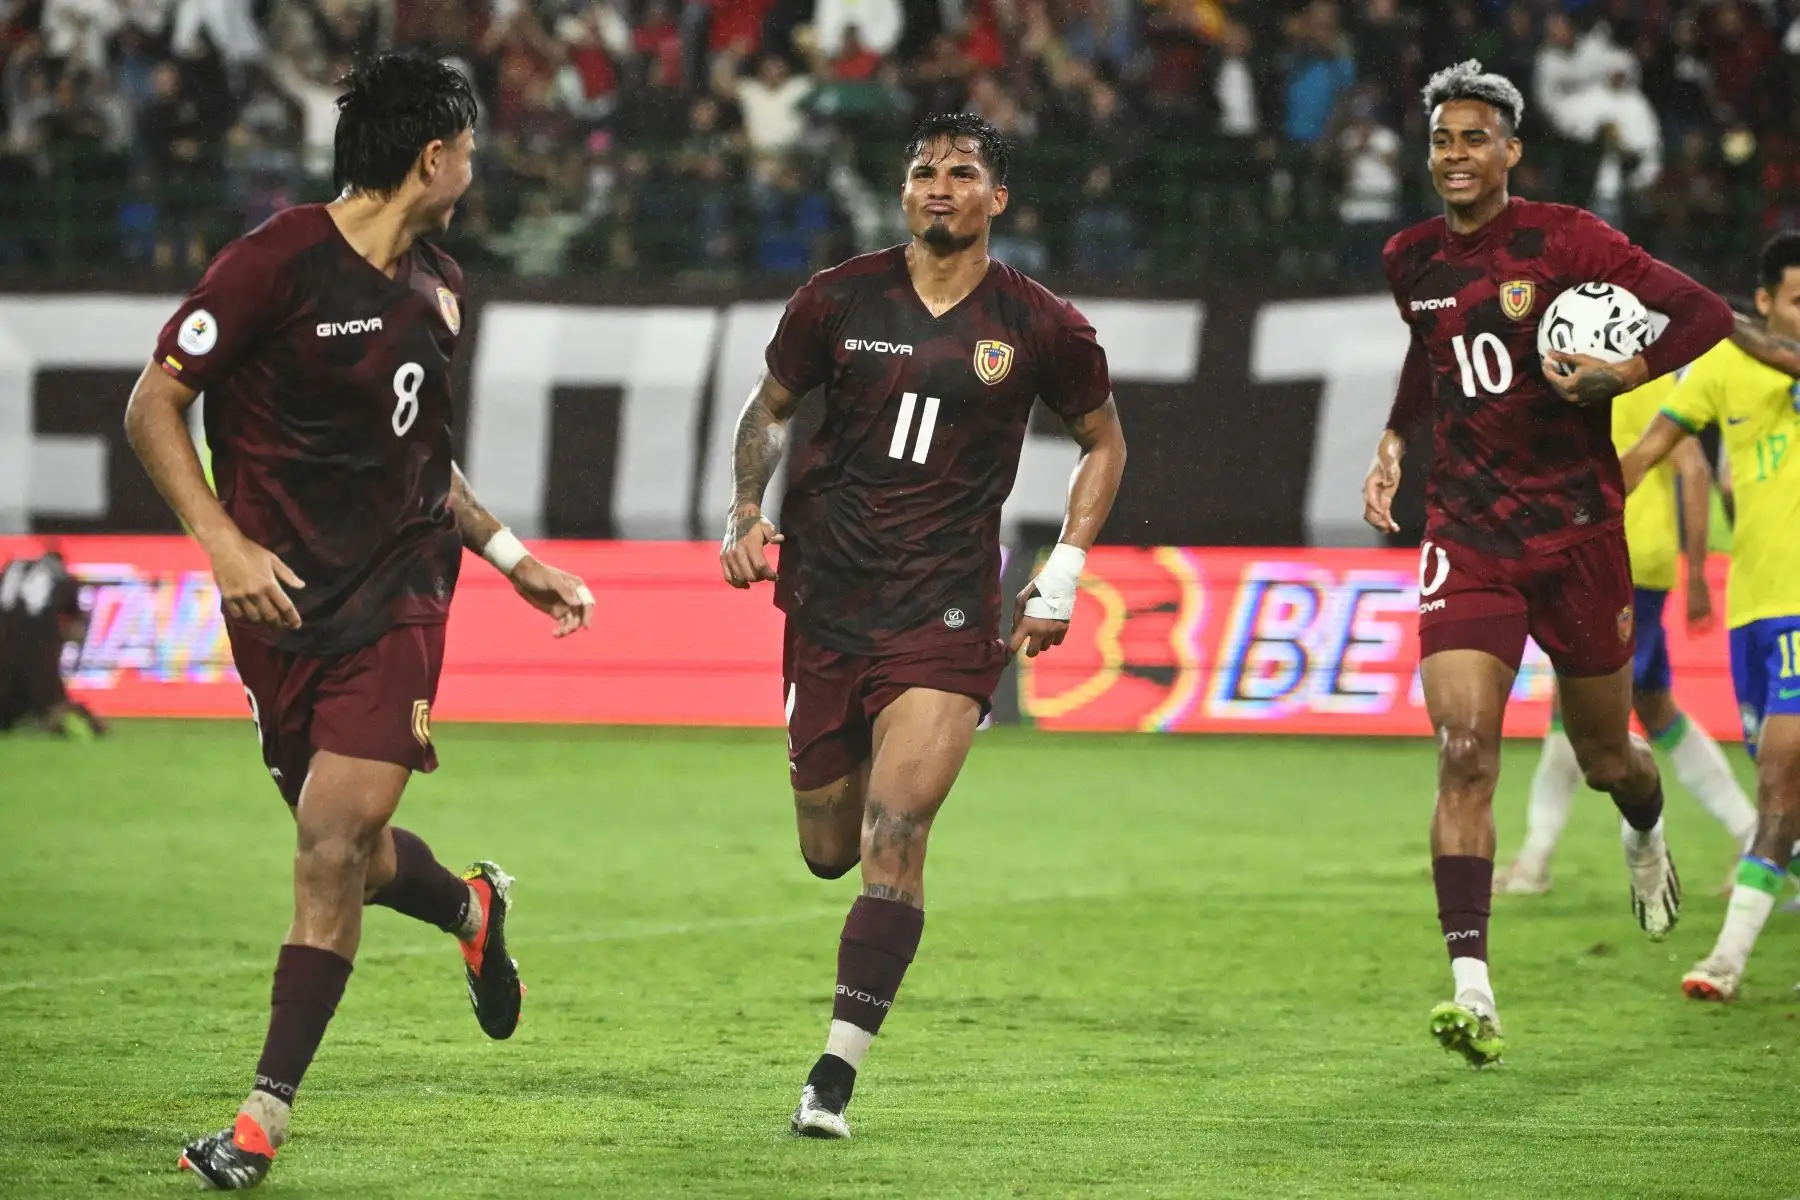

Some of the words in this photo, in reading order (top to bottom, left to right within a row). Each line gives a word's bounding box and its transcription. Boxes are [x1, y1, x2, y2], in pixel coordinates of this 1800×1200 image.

[316, 317, 383, 337] GIVOVA
[844, 338, 913, 356] GIVOVA
[1451, 332, 1513, 398] 10
[392, 361, 425, 437] 8
[888, 392, 941, 464] 11
[1419, 541, 1451, 597] 0
[1419, 598, 1446, 615] OVA
[1444, 929, 1480, 942] OVA
[836, 984, 892, 1010] GIVOVA
[256, 1074, 296, 1096] GIVO
